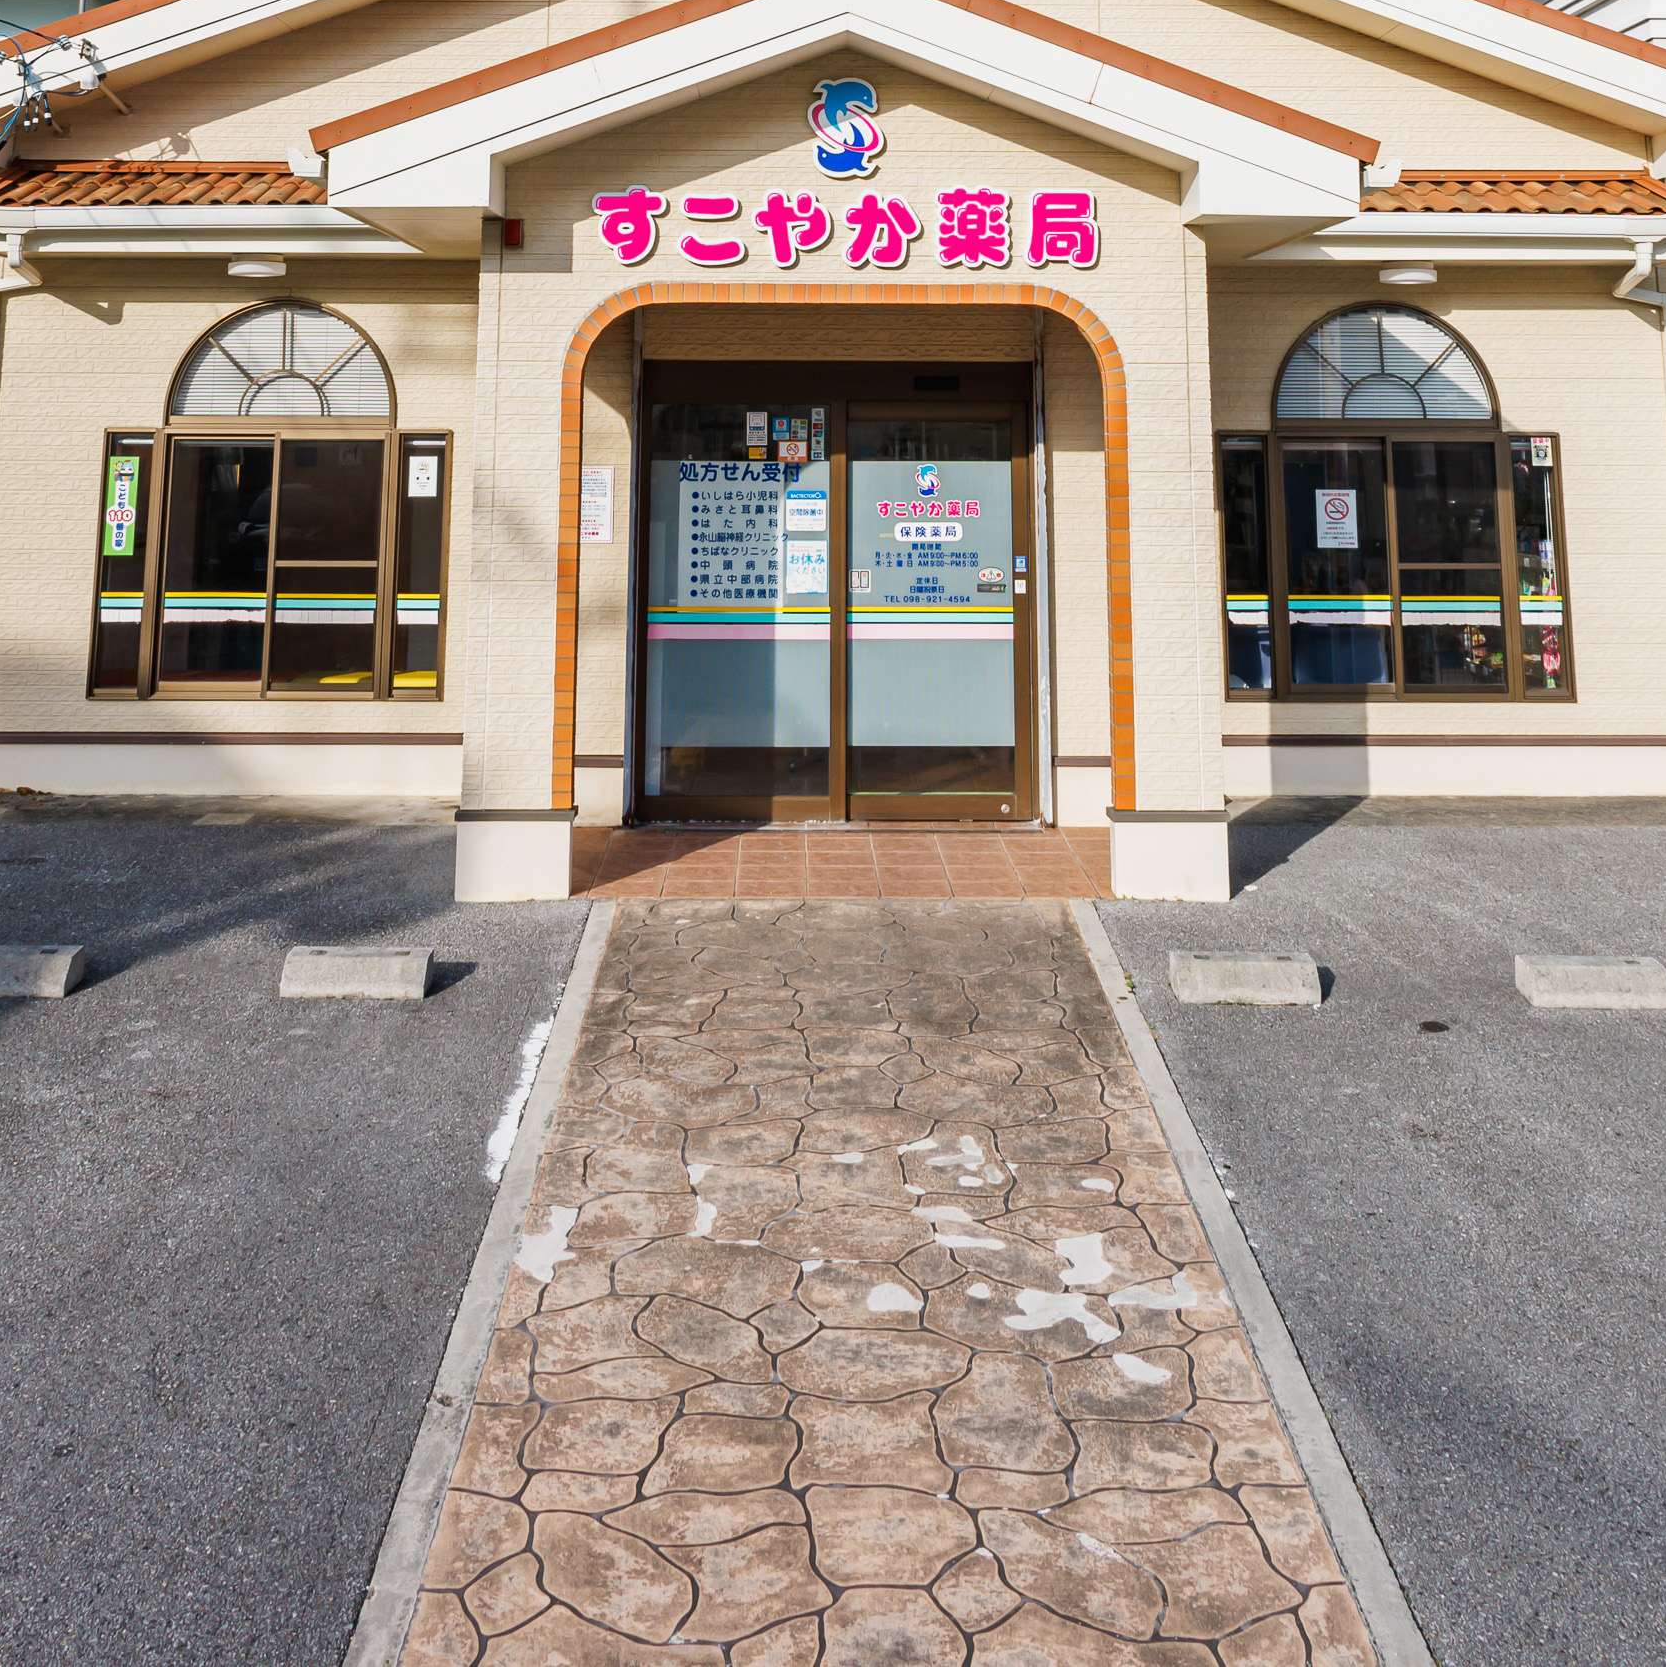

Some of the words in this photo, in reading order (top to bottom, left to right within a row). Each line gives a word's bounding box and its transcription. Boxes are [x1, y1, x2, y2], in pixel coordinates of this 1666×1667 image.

[593, 186, 1098, 267] すこやか薬局
[679, 461, 802, 483] 処方せん受付
[701, 490, 779, 501] いしはら小児科
[701, 504, 778, 515] みさと耳鼻科
[877, 500, 981, 518] すこやか薬局
[701, 518, 778, 529] はた内科
[900, 526, 957, 538] 保険薬局
[701, 546, 779, 556] ちばなクリニック
[789, 553, 825, 565] お休み
[700, 560, 779, 570] 中頭病院
[699, 574, 779, 585] 県立中部病院
[700, 588, 778, 599] その他医療機関
[884, 595, 901, 603] TEL
[903, 595, 970, 603] 098-921-4594
